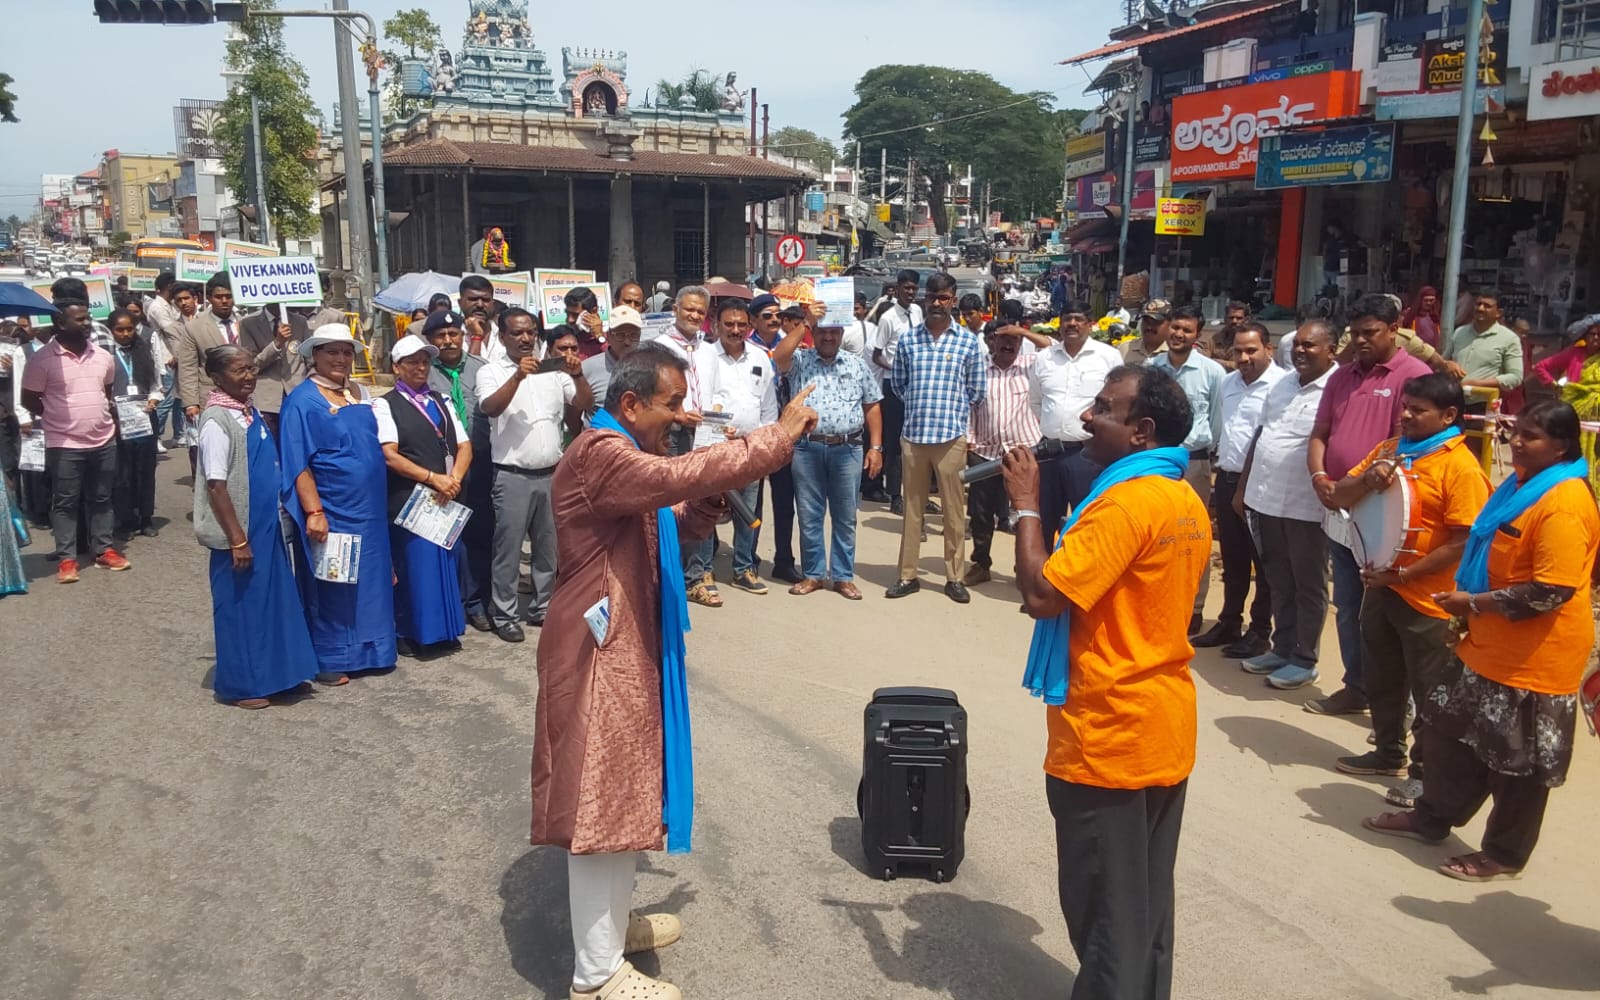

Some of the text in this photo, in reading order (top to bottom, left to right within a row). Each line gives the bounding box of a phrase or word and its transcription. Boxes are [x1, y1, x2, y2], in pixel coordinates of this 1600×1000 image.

[1294, 62, 1324, 75] oppo
[1254, 72, 1281, 83] vivo
[1164, 218, 1196, 227] XEROX
[230, 262, 316, 279] VIVEKANANDA
[240, 281, 315, 297] PU COLLEGE
